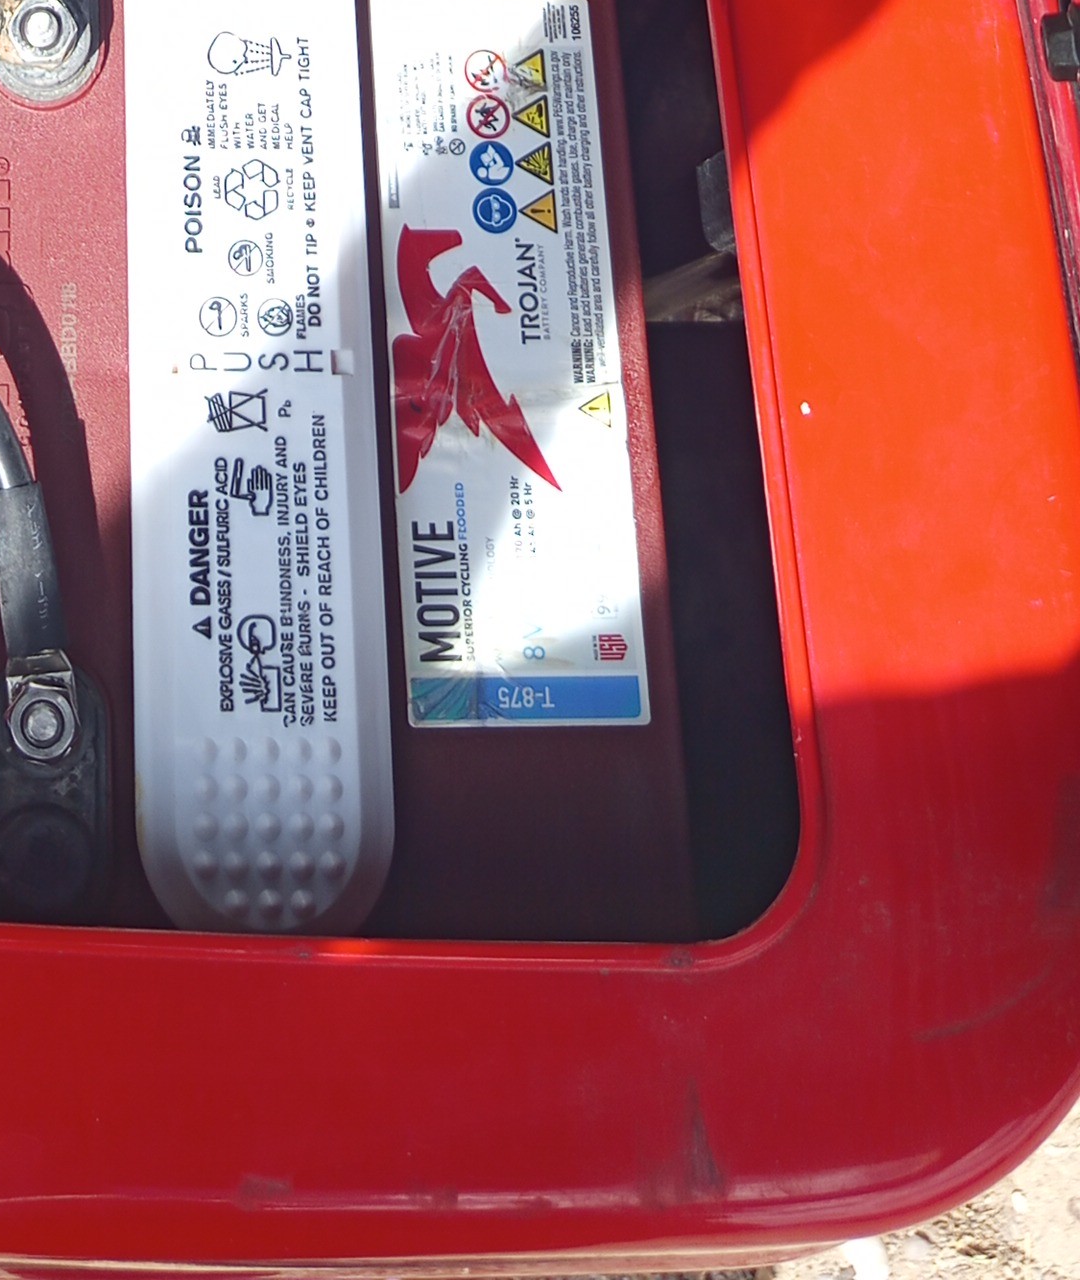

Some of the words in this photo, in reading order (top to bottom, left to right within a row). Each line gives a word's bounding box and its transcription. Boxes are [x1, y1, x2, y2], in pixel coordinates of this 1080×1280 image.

[570, 4, 582, 41] 106255
[296, 37, 310, 81] TIGHT
[560, 52, 572, 67] only
[573, 50, 584, 92] instructions.
[218, 82, 228, 110] EYES
[562, 68, 574, 100] maintain
[257, 102, 267, 124] GET
[298, 88, 313, 119] CAP
[564, 100, 574, 114] and
[576, 94, 586, 112] other
[219, 114, 229, 150] FLUSH
[232, 122, 242, 150] WITH
[245, 112, 254, 150] WATER
[270, 102, 281, 150] MEDICAL
[284, 122, 294, 150] HELP
[565, 115, 579, 141] charge
[578, 114, 588, 128] and
[258, 126, 268, 150] AND
[300, 126, 315, 166] VENT
[568, 142, 580, 159] Use,
[578, 129, 591, 160] charging
[212, 176, 222, 200] LEAD
[558, 168, 568, 186] after
[568, 160, 580, 184] gases.
[581, 162, 594, 188] battery
[182, 155, 203, 254] POISON
[285, 168, 294, 210] RECYCLE
[302, 171, 316, 212] KEEP
[560, 186, 570, 207] hands
[583, 190, 594, 210] other
[560, 208, 572, 228] Wash
[570, 184, 584, 230] combustible
[304, 232, 318, 256] TIP
[563, 230, 572, 250] Harm.
[574, 232, 588, 264] generate
[586, 222, 596, 244] follow
[264, 232, 275, 284] SMOKING
[536, 245, 548, 294] COMPANY
[564, 252, 580, 296] Reproductive
[588, 246, 600, 276] carefully
[305, 265, 321, 298] NOT
[516, 243, 542, 345] TROJAN
[576, 266, 590, 300] batteries
[590, 278, 600, 293] and
[239, 292, 250, 338] SPARKS
[295, 294, 307, 340] FLAMES
[307, 302, 322, 327] DO
[540, 296, 550, 340] BATTERY
[568, 297, 578, 310] and
[580, 300, 590, 318] acid
[592, 294, 602, 312] area
[568, 310, 581, 337] Cancer
[580, 318, 592, 338] Lead
[188, 350, 324, 373] PUSH
[572, 338, 584, 384] WARNING:
[584, 338, 596, 384] WARNING:
[274, 436, 288, 468] AND
[312, 414, 328, 501] CHILDREN
[214, 456, 229, 496] ACID
[292, 462, 307, 506] EYES
[509, 476, 520, 490] Hr
[524, 482, 532, 494] Hr
[276, 474, 290, 526] INJURY
[455, 482, 468, 540] FLOODED
[510, 492, 520, 506] 20
[215, 498, 230, 568] SULFURIC
[316, 506, 330, 531] OF
[188, 488, 211, 606] DANGER
[294, 513, 310, 577] SHIELD
[316, 536, 332, 596] REACH
[458, 543, 472, 597] CYCLING
[217, 580, 232, 630] GASES
[412, 521, 462, 662] MOTIVE
[320, 602, 334, 626] OF
[280, 632, 295, 686] CAUSE
[320, 632, 335, 670] OUT
[598, 634, 628, 660] USA
[219, 634, 234, 712] EXPLOSIVE
[322, 675, 338, 722] KEEP
[498, 686, 556, 708] T-875
